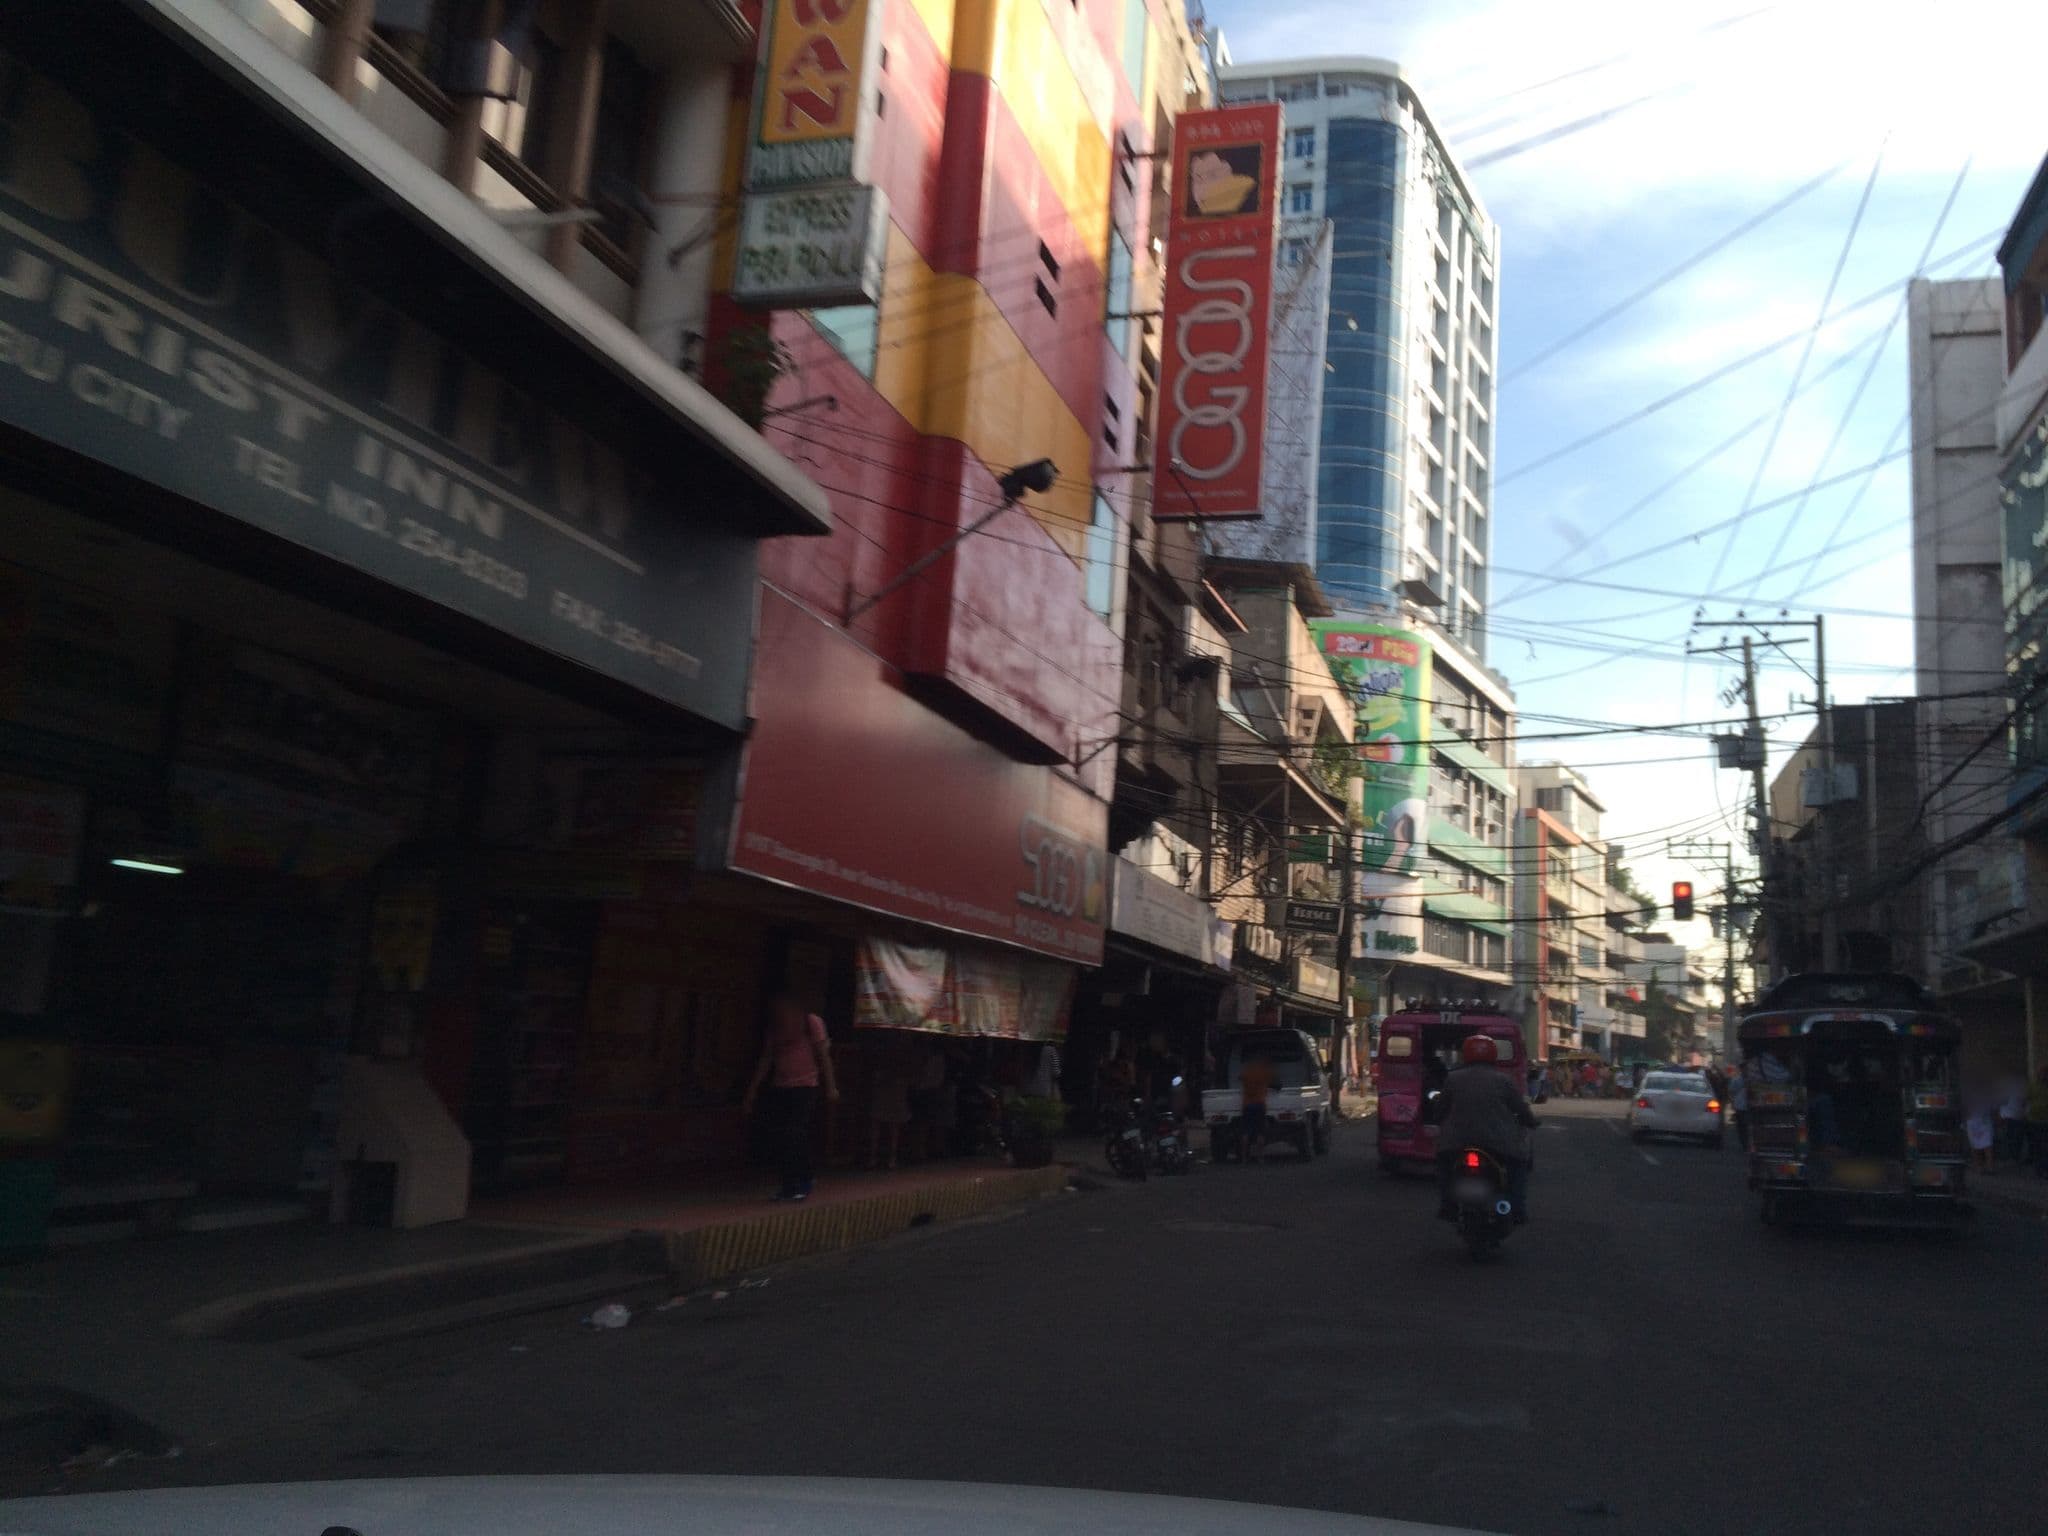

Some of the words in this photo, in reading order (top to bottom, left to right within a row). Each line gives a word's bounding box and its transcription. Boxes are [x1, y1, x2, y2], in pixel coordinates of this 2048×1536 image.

[70, 361, 194, 441] CITY
[1168, 246, 1257, 480] SOGO
[354, 433, 505, 541] INN
